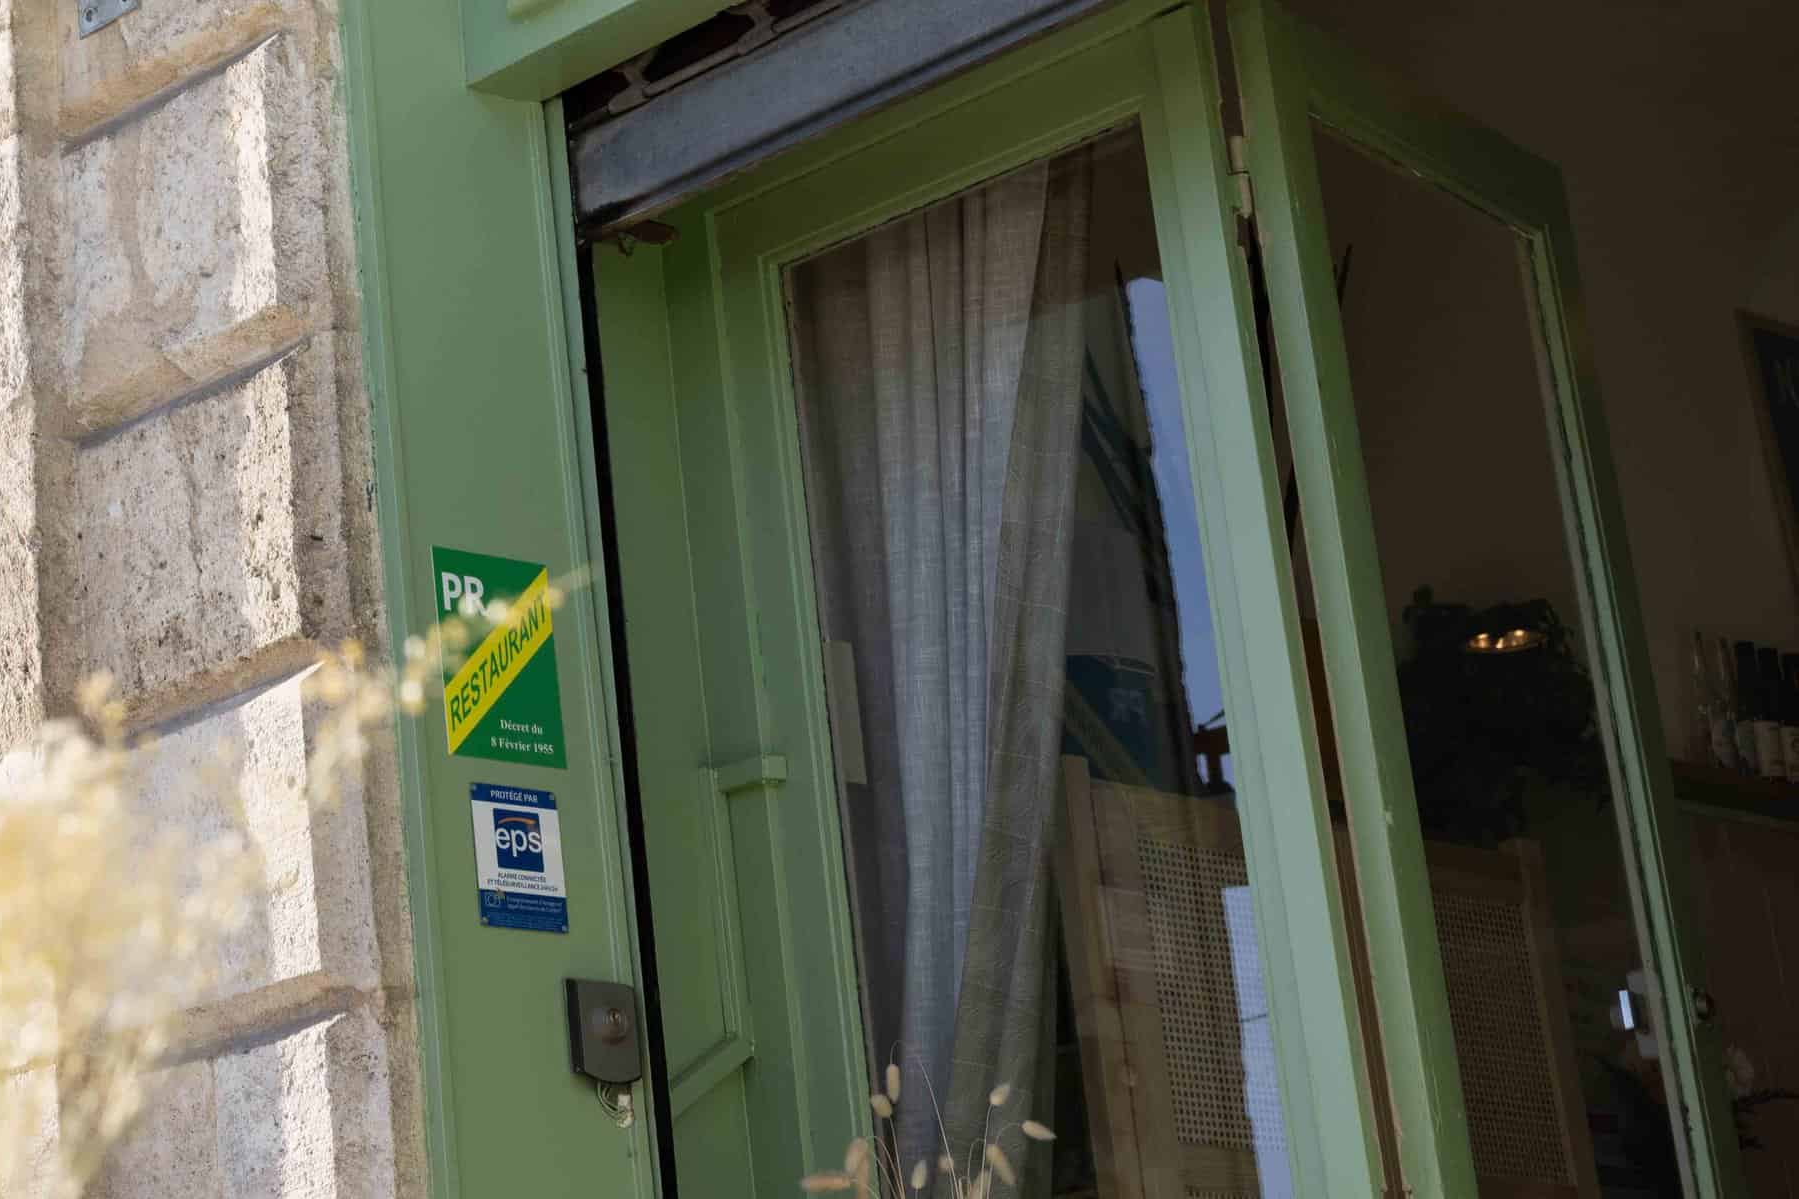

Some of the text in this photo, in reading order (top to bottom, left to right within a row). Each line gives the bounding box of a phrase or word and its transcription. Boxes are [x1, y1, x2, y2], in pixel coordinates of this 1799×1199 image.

[450, 591, 547, 732] RESTAURANT
[531, 723, 543, 736] du
[496, 828, 543, 857] eps
